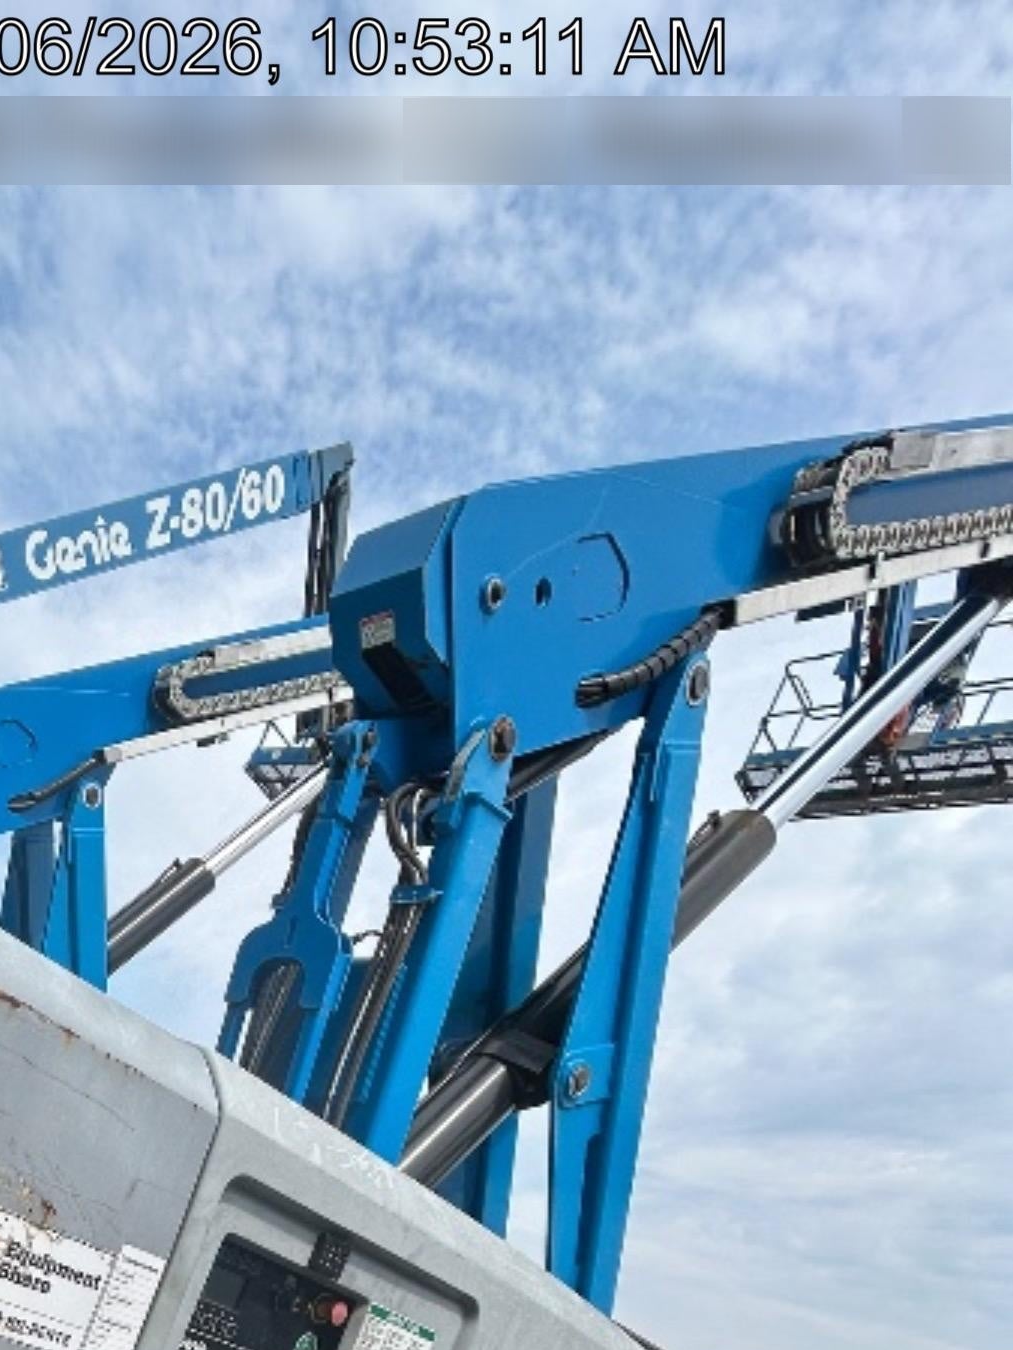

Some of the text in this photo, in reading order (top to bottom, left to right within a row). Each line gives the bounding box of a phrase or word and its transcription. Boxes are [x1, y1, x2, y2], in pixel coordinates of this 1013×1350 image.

[25, 463, 286, 580] Genie Z-80/60
[4, 1240, 102, 1291] Equipment
